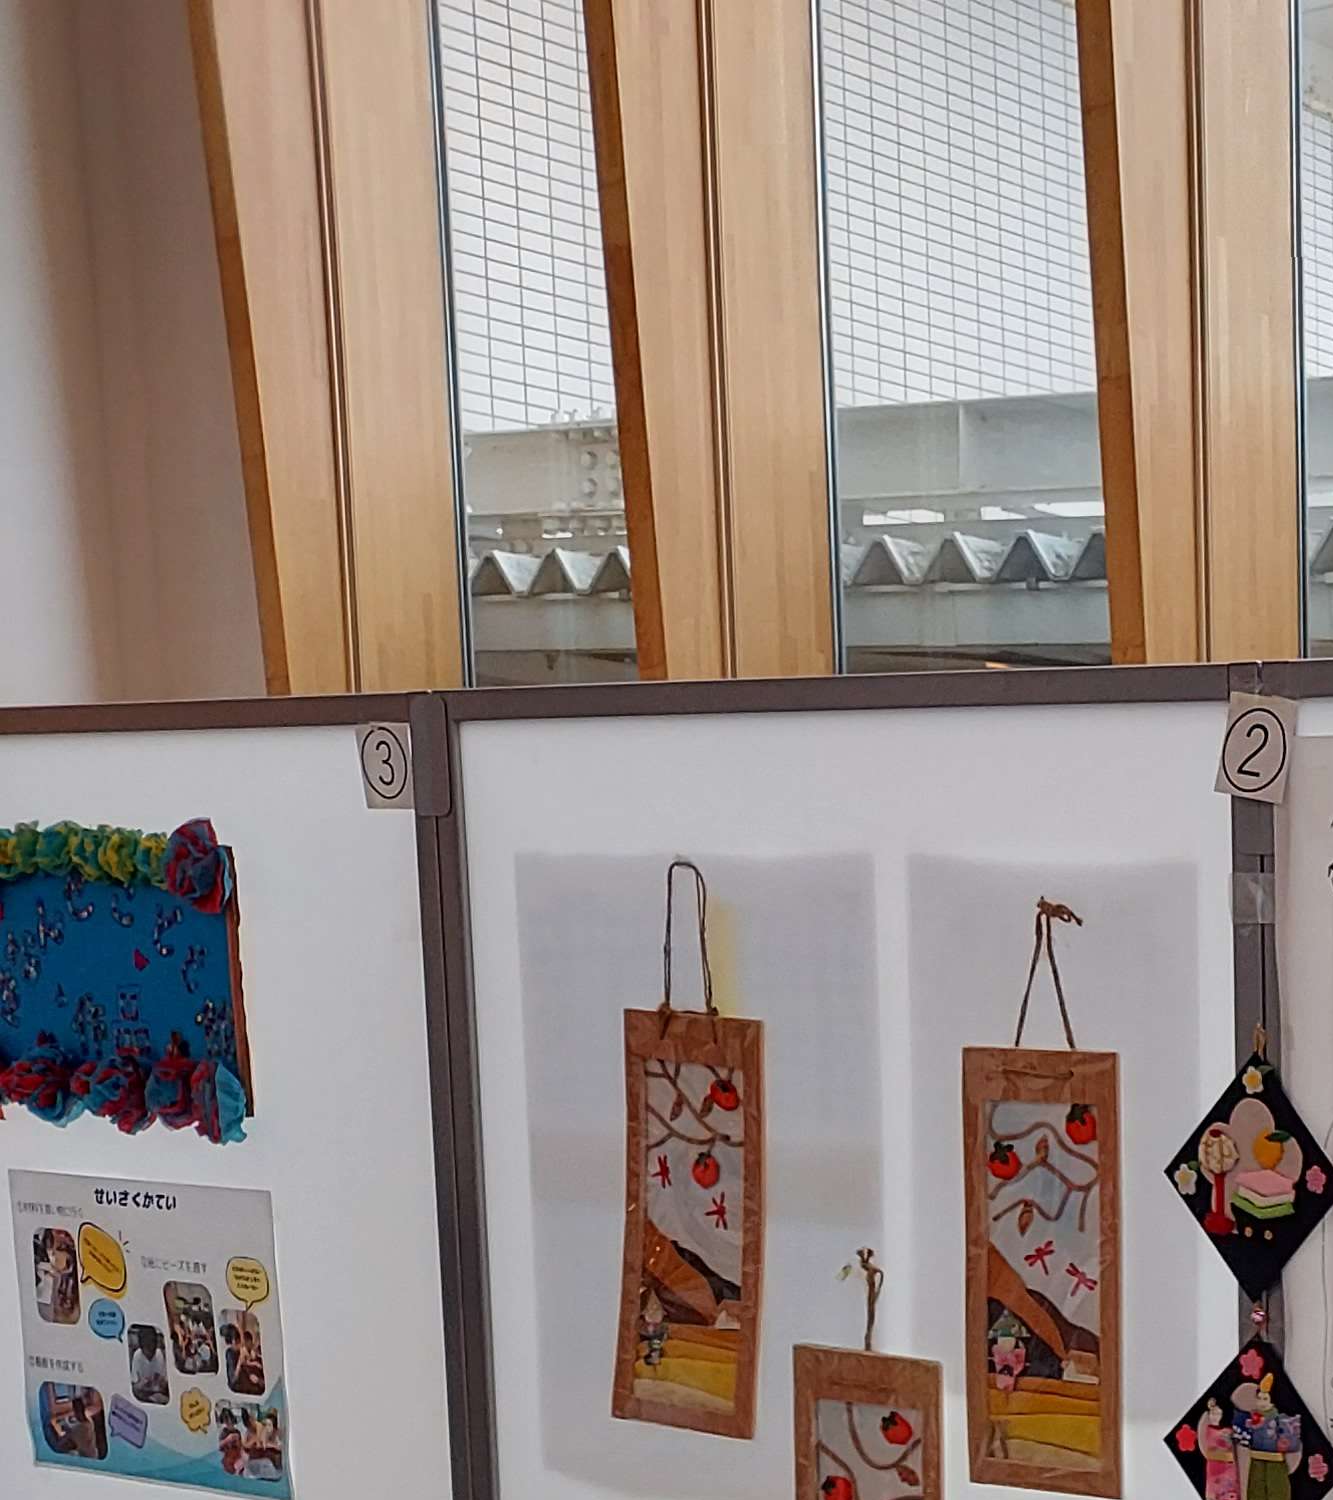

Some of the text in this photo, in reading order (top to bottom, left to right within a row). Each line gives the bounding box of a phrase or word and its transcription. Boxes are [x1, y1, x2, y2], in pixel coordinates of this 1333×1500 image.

[94, 1187, 177, 1210] せいさくかてい
